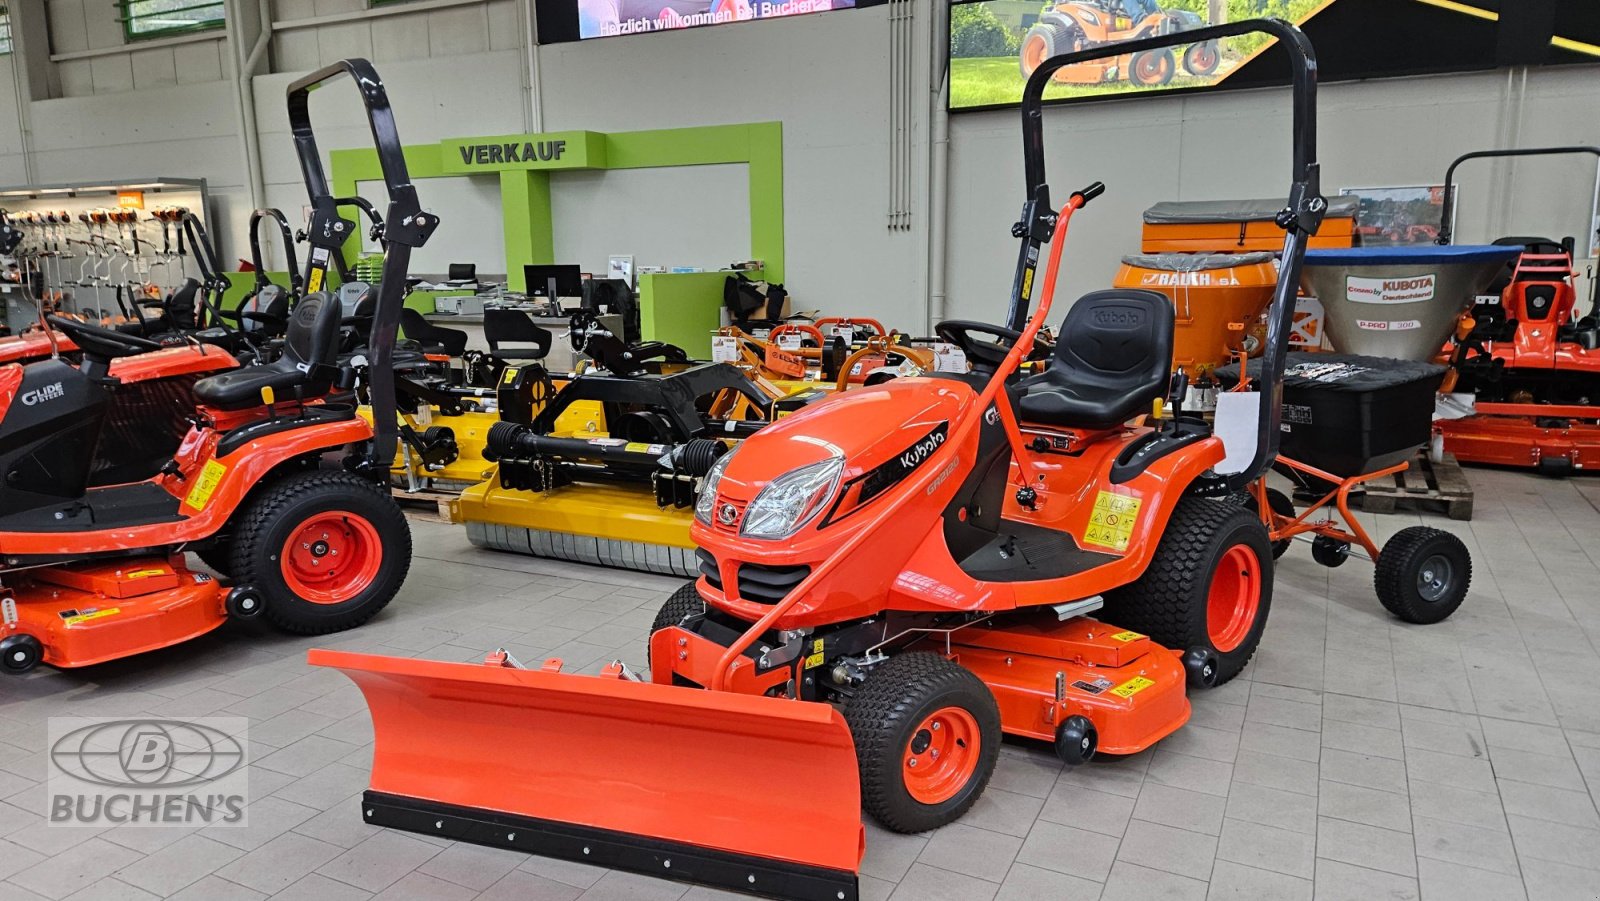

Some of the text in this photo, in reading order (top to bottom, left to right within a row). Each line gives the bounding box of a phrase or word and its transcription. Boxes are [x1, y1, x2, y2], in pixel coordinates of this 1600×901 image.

[600, 0, 832, 36] Herzlich willkommen bei Buchen
[459, 140, 566, 165] VERKAUF
[1158, 272, 1240, 286] RAUCH SA
[1382, 278, 1433, 291] KUBOTA
[1382, 291, 1433, 301] Deutschland
[1095, 310, 1139, 323] Kubota
[21, 381, 63, 406] GLIDE
[900, 432, 945, 468] Kubota
[926, 455, 960, 496] GR2120
